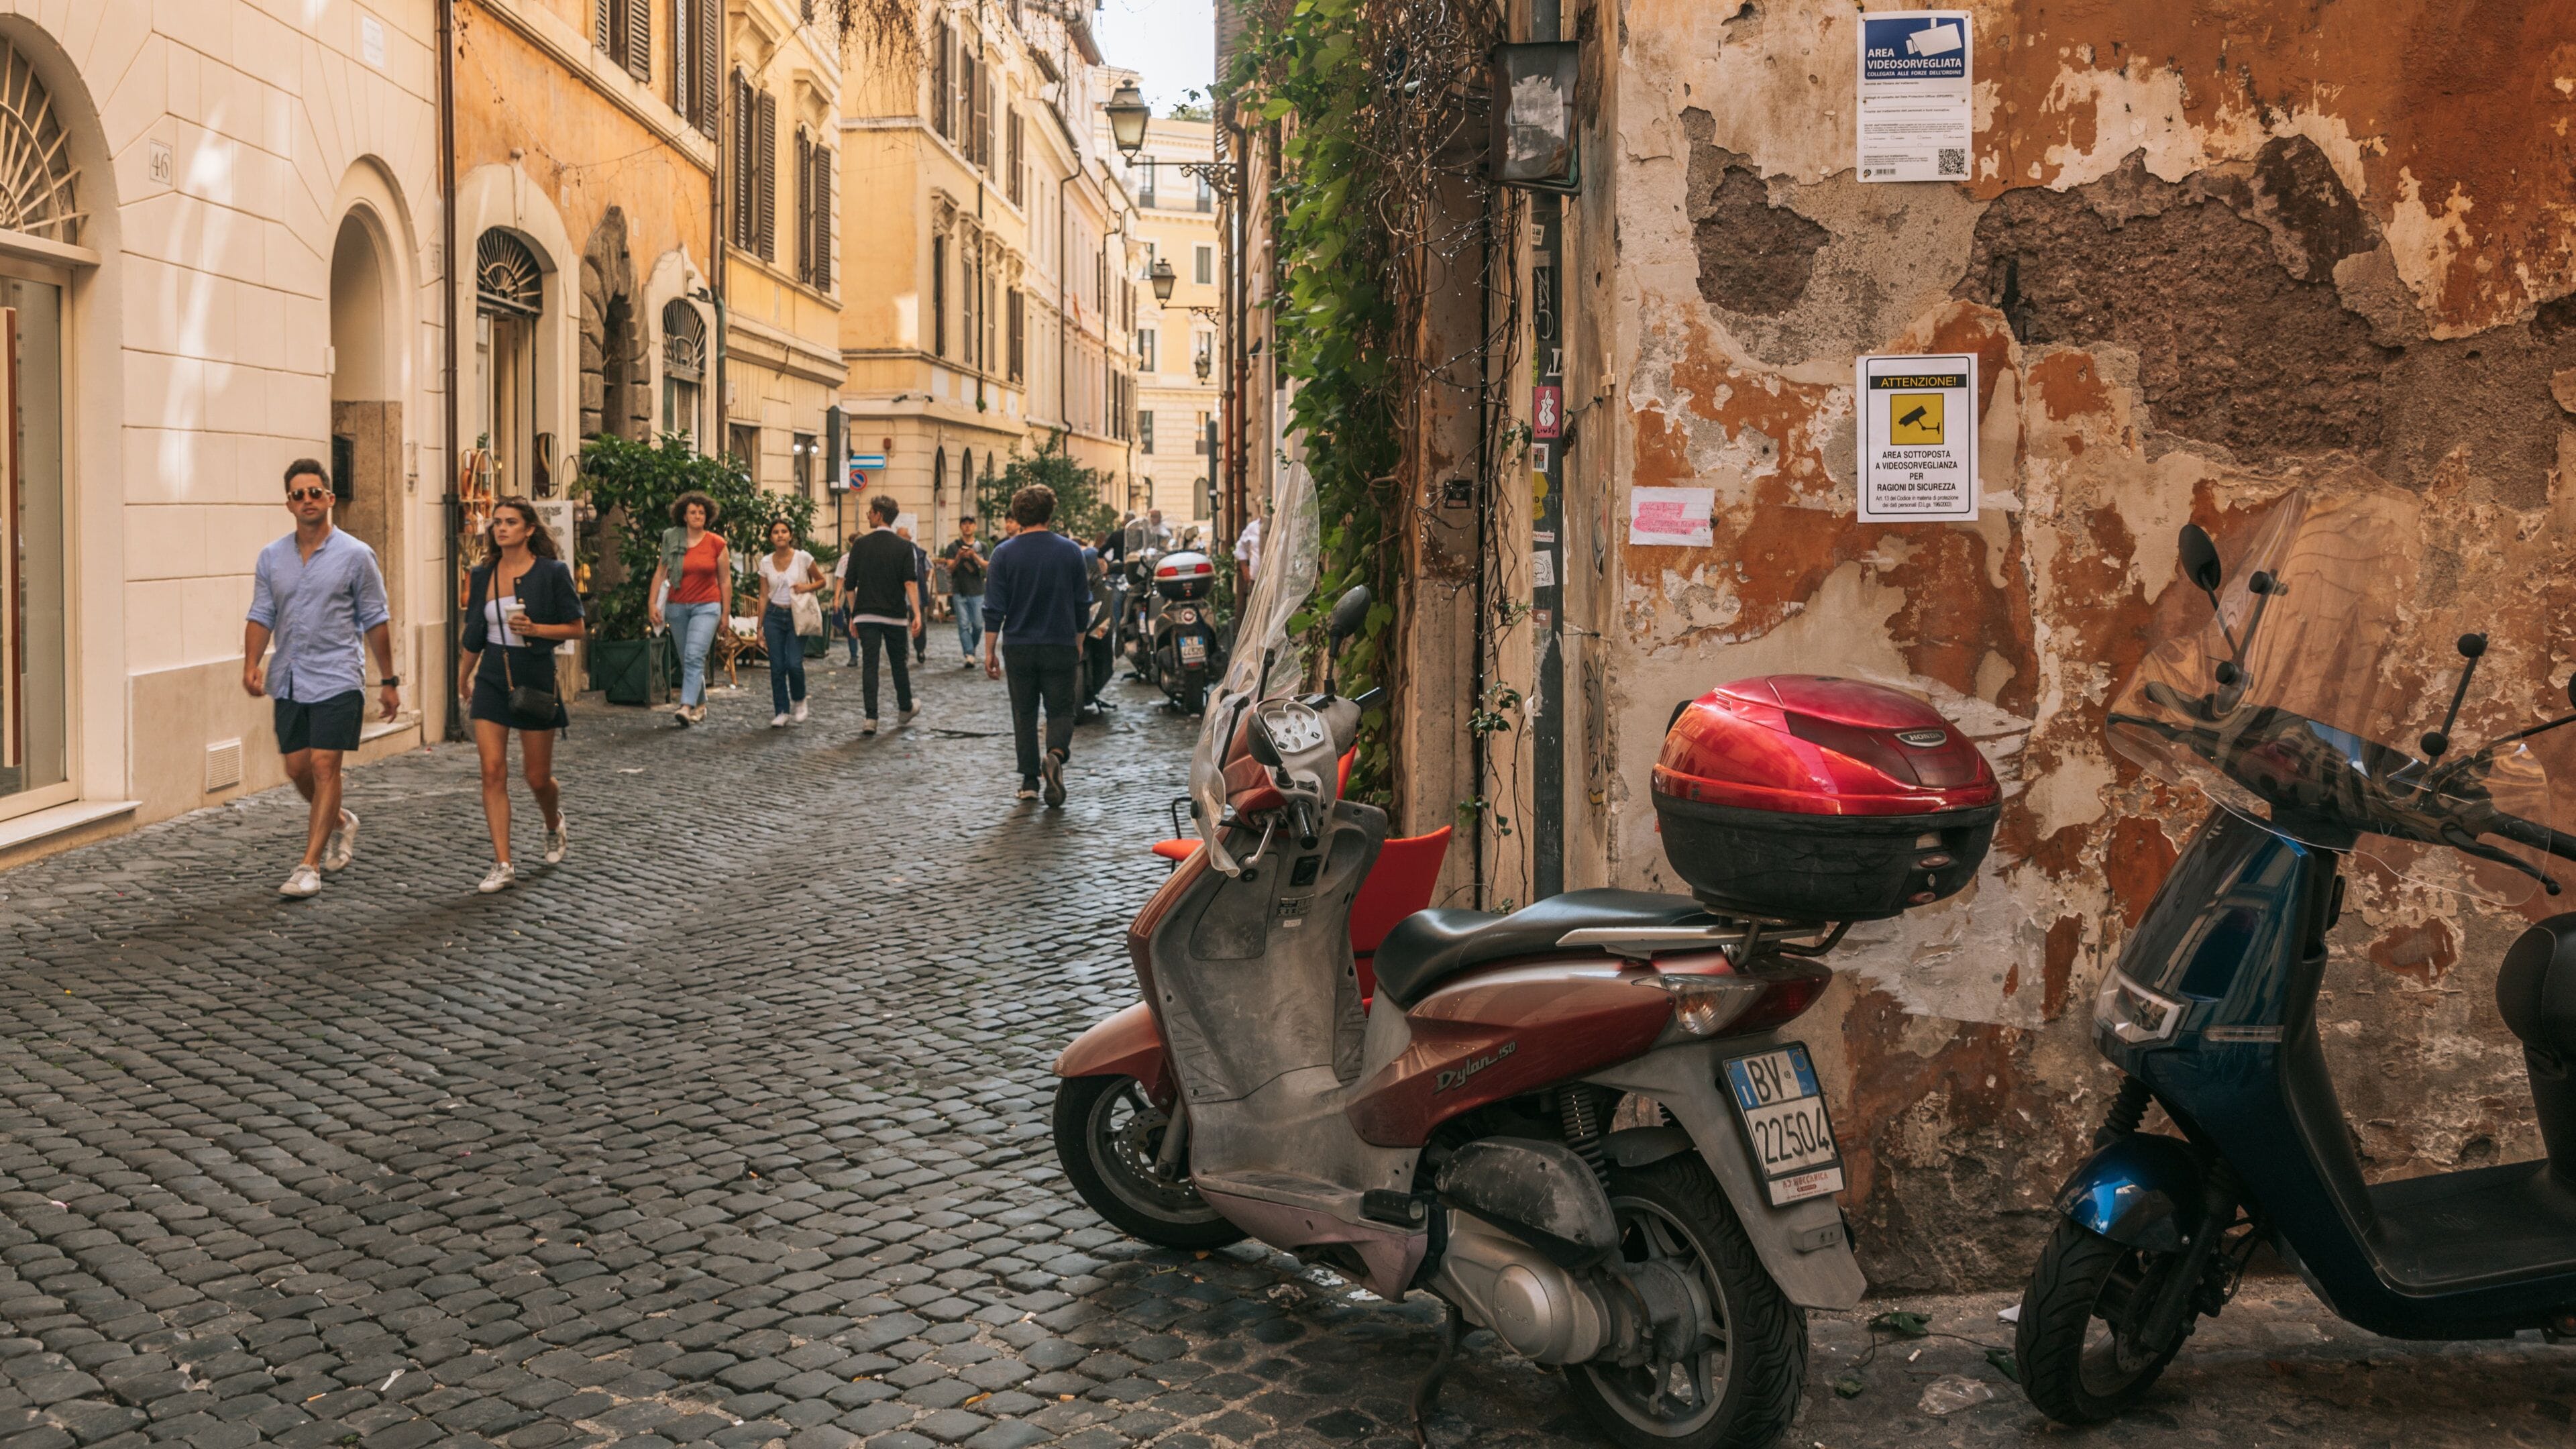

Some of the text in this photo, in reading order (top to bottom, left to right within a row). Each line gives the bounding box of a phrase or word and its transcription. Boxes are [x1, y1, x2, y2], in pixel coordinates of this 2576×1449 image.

[1867, 48, 1894, 58] AREA
[1867, 58, 1962, 69] VIDEOSORVEGLIATA
[152, 152, 170, 179] 46
[1880, 376, 1957, 387] ATTENZIONE!
[1903, 450, 1951, 458] SOTTOPOSTA
[1882, 461, 1957, 470] VIDEOSORVEGLIANZA
[1877, 482, 1956, 491] RAGIONI DI SICUREZZA
[1908, 732, 1941, 741] HONDA
[1434, 1057, 1498, 1094] Dylan
[1747, 1055, 1784, 1103] BV
[1754, 1108, 1831, 1165] 22504
[1792, 1171, 1829, 1187] MECCANICA
